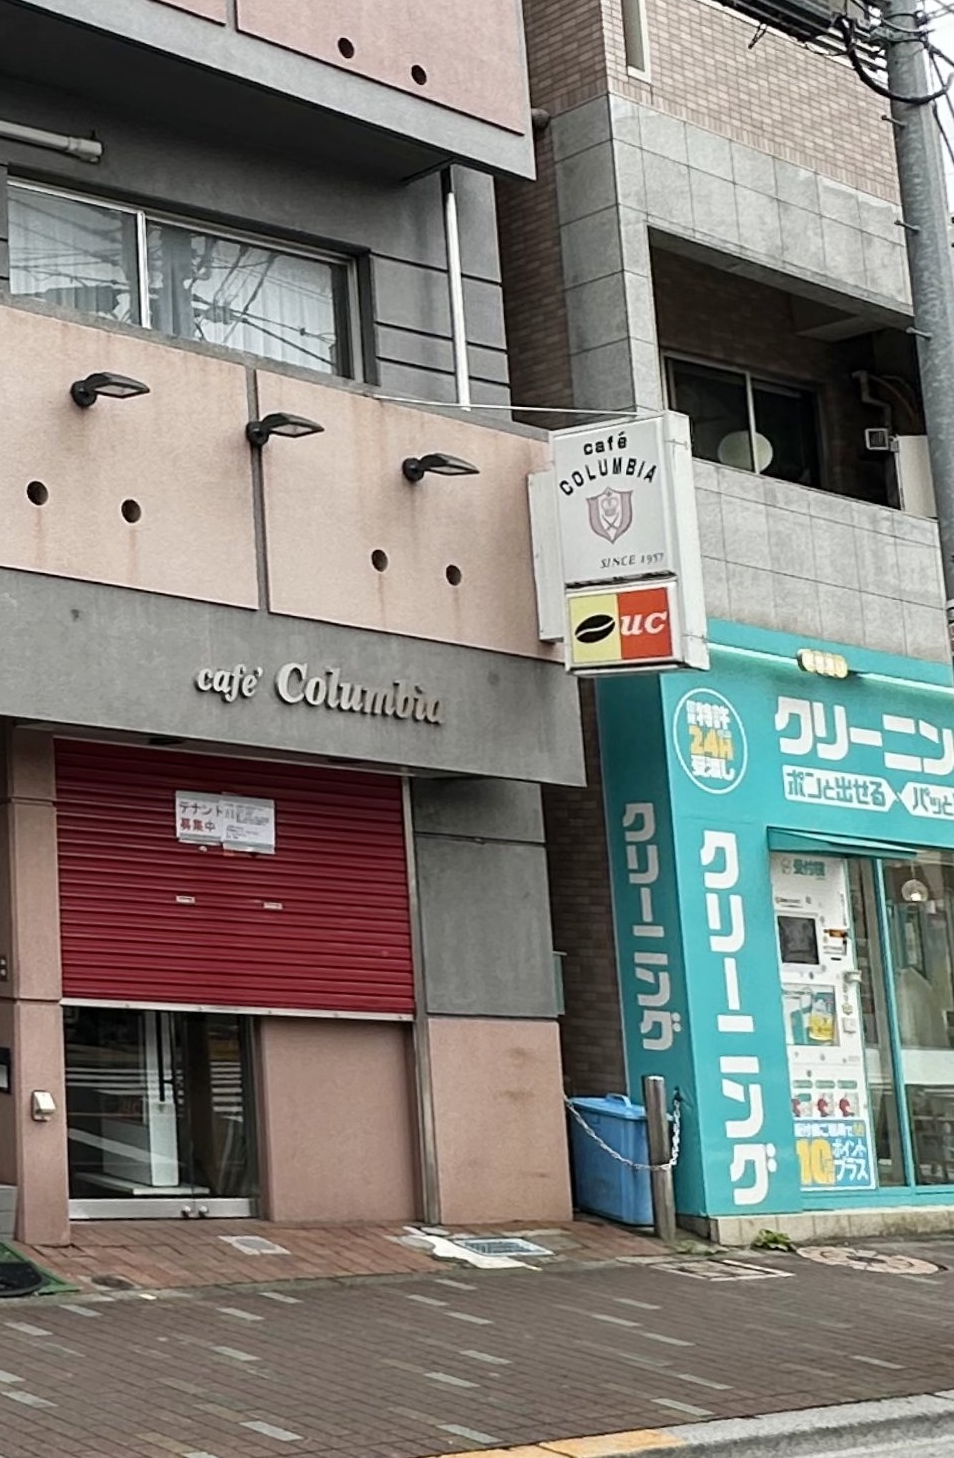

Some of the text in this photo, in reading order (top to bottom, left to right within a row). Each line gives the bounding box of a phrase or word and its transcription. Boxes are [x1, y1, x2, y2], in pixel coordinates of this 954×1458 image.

[583, 432, 627, 456] café
[559, 457, 658, 496] COLUMBIA
[599, 551, 665, 569] SINCE 1957
[196, 661, 445, 724] café Columbia
[786, 769, 887, 808] ポンと出せる
[178, 800, 223, 817] テナント
[622, 802, 682, 1051] クリーニング
[699, 829, 778, 1206] クリーニング
